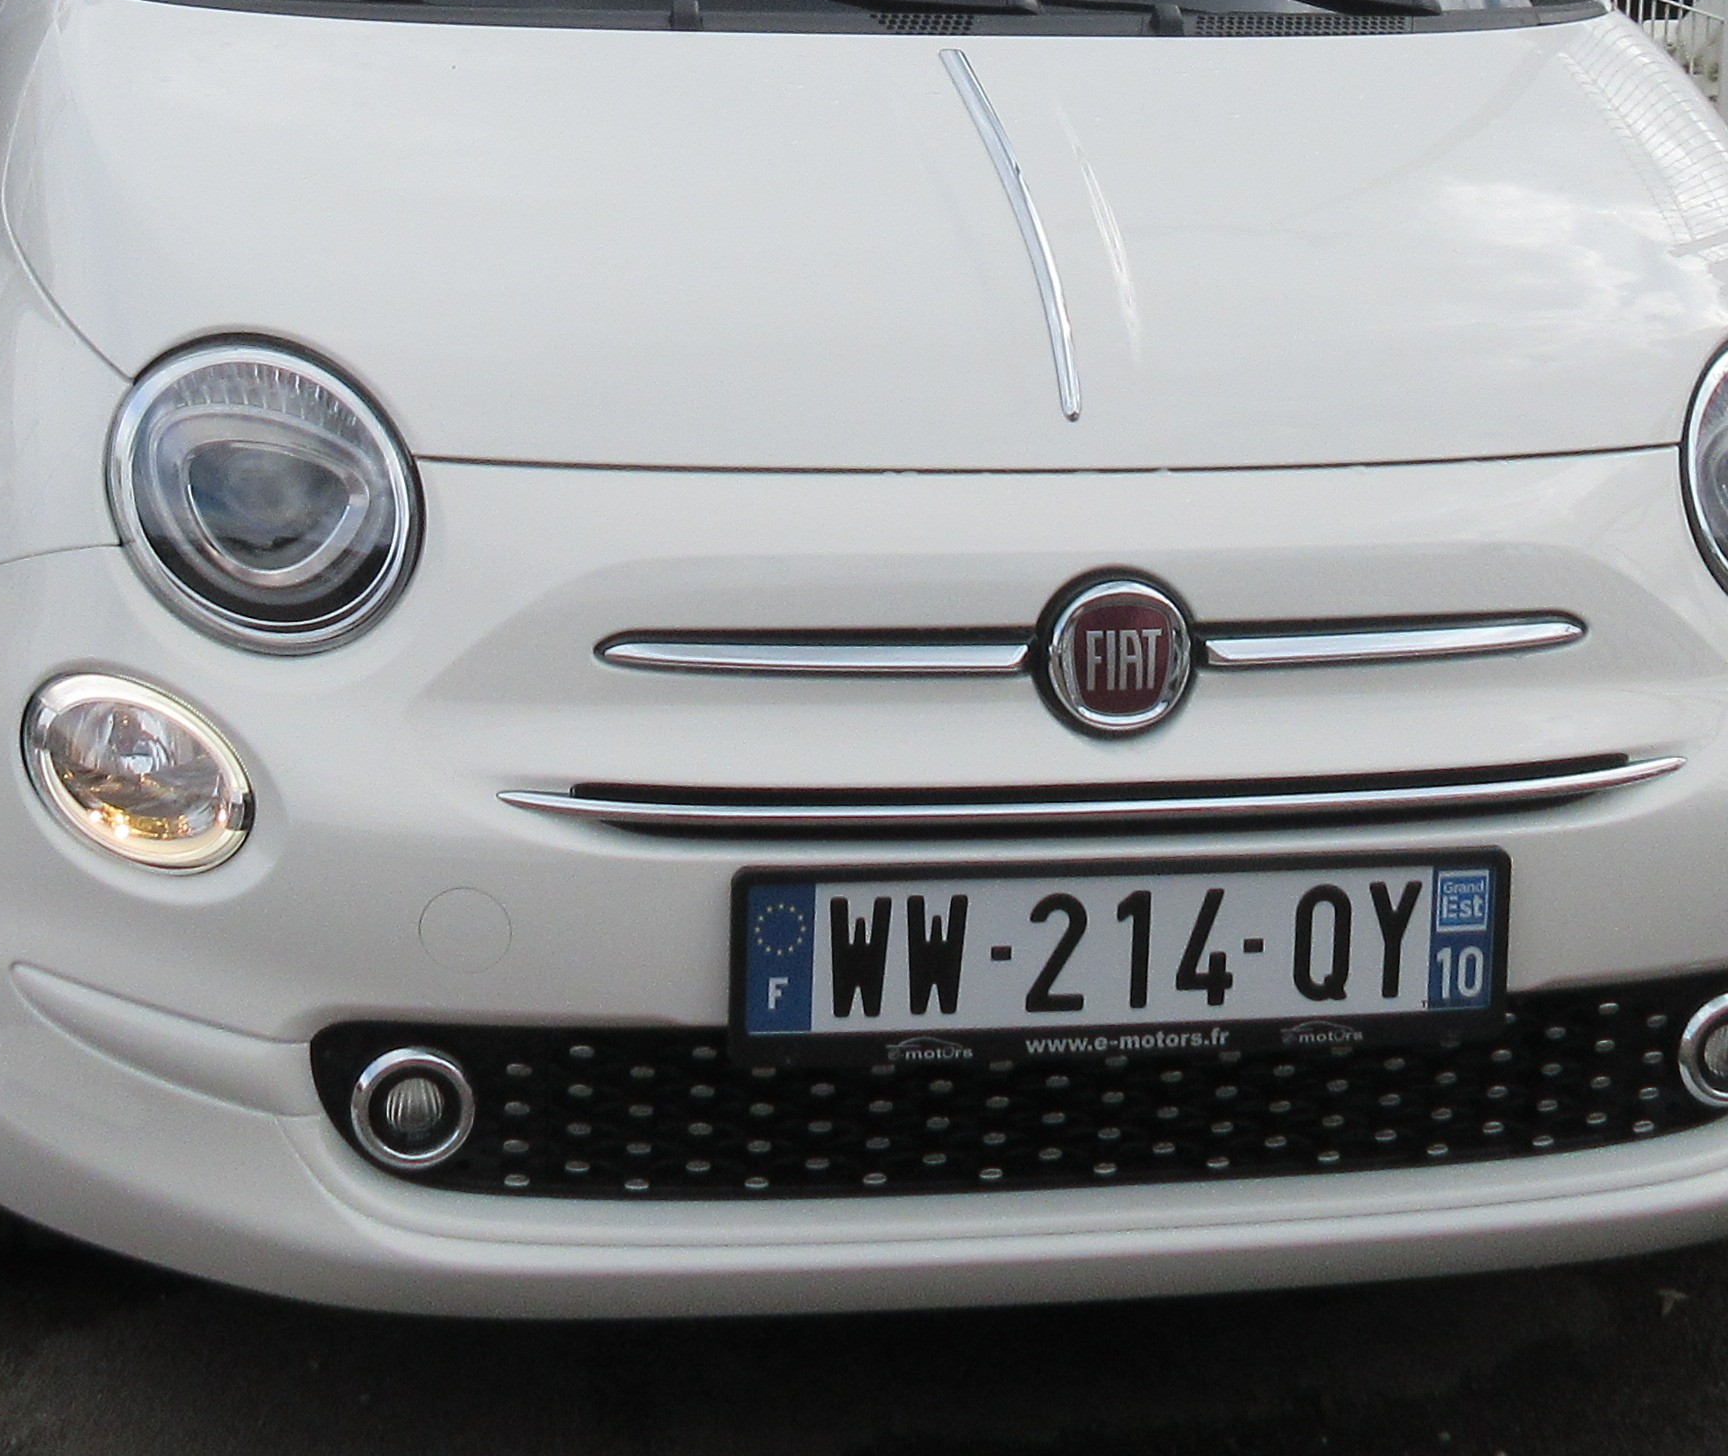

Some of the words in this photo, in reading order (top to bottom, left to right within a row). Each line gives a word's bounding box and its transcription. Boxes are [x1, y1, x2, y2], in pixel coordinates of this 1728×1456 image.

[1085, 628, 1163, 692] FIAT
[1443, 880, 1484, 894] Grand
[1441, 894, 1484, 919] Est
[829, 881, 1422, 1018] WW-214-QY
[1436, 945, 1484, 999] 10
[768, 977, 789, 1009] F
[1025, 1027, 1230, 1053] www.e-motors.fr
